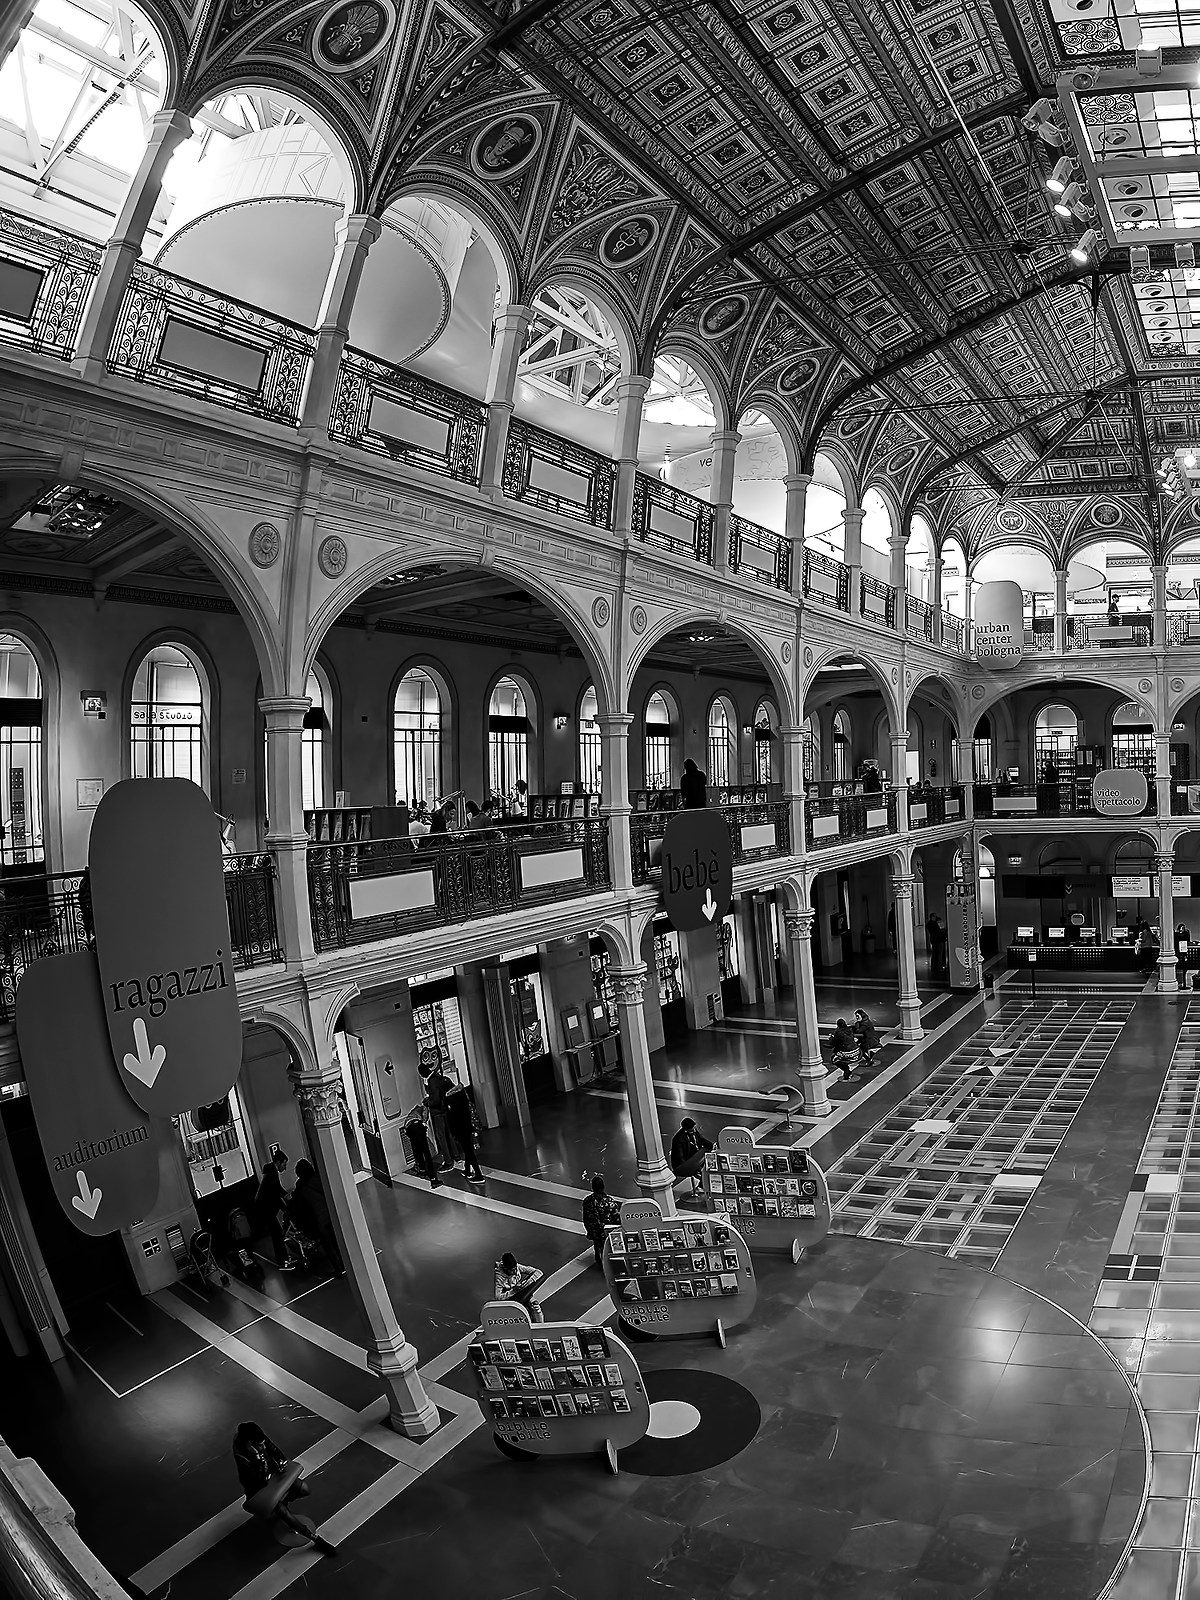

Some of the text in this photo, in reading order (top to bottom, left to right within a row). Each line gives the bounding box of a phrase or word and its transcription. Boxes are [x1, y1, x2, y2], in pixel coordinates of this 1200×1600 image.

[976, 622, 1010, 634] urban
[976, 634, 1012, 645] center
[977, 645, 1021, 659] bologna
[1096, 788, 1120, 797] video
[1096, 797, 1142, 809] spettacolo
[665, 849, 720, 894] bebè
[109, 948, 229, 1018] ragazzi
[53, 1125, 150, 1172] auditorium
[622, 1304, 668, 1317] biblio
[496, 1421, 548, 1432] biblio
